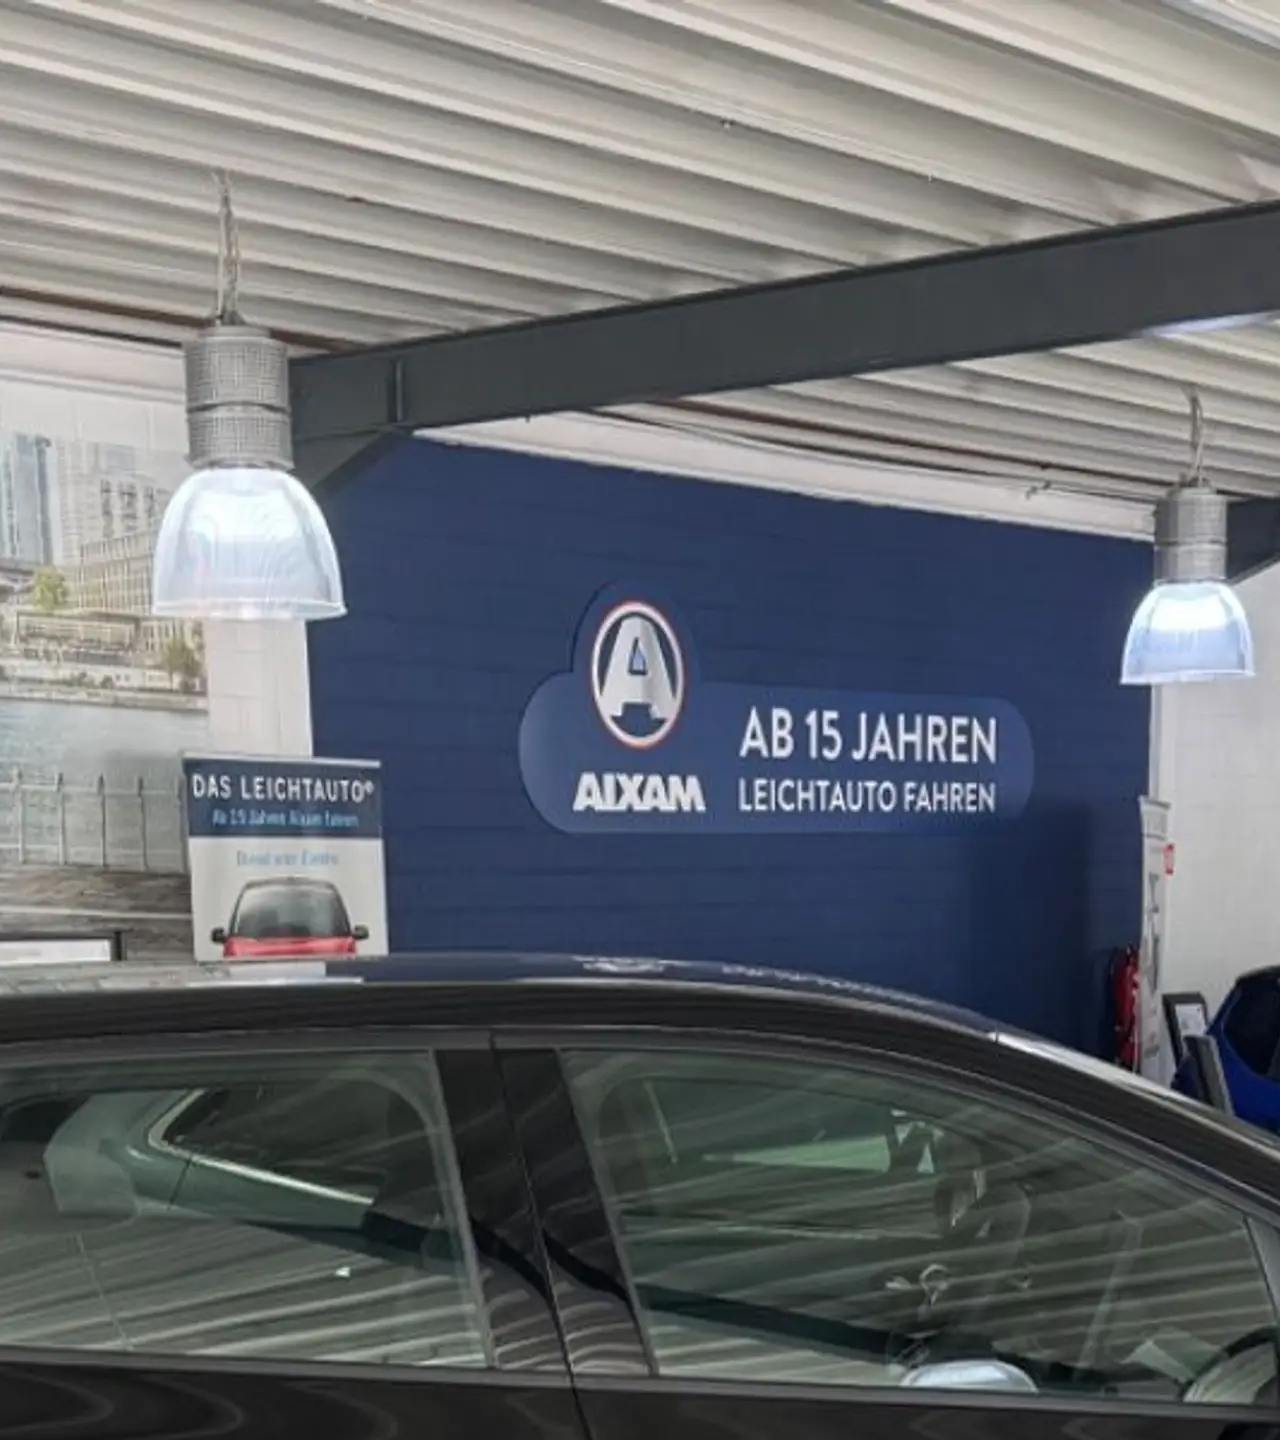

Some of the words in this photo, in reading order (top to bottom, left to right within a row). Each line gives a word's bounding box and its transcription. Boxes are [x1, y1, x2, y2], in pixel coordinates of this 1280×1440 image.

[739, 706, 795, 759] AB
[805, 709, 844, 761] 15
[851, 712, 998, 764] JAHREN
[192, 773, 232, 799] DAS
[572, 771, 707, 812] AIXAM
[738, 778, 897, 812] LEICHTAUTO
[903, 781, 997, 813] FAHREN
